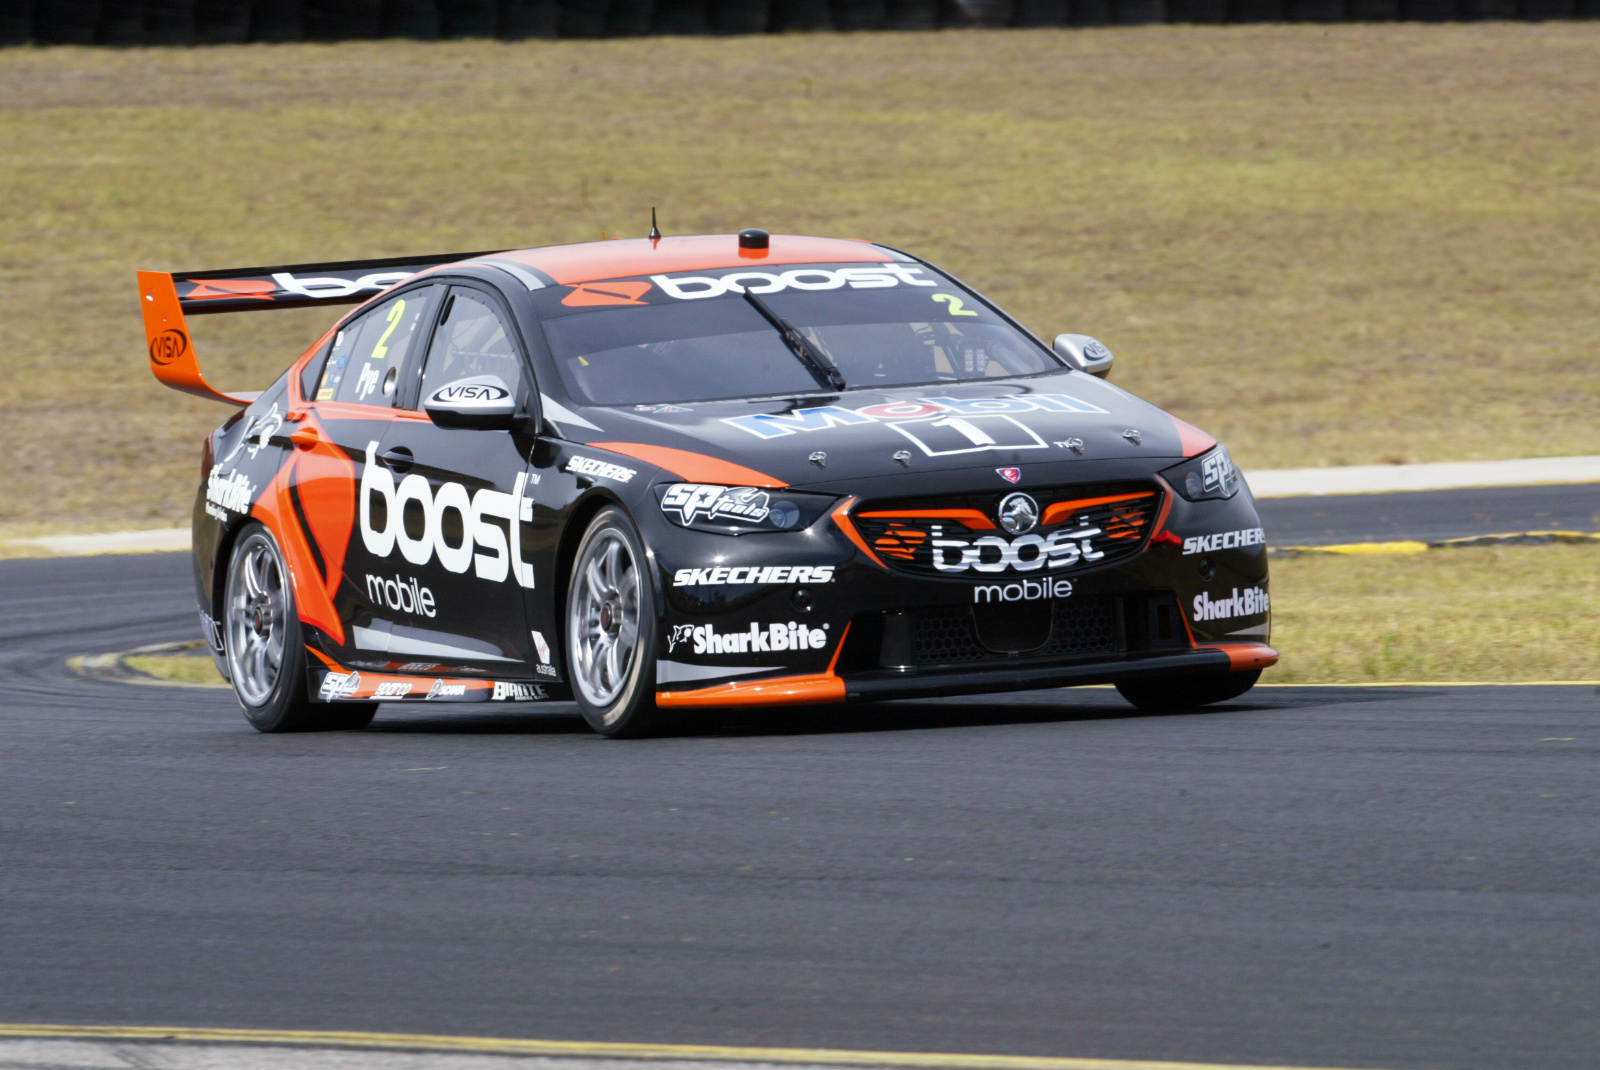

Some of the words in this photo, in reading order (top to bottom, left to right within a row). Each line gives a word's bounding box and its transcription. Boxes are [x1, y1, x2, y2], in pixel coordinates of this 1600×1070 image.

[650, 263, 938, 300] boost
[931, 293, 979, 316] 2
[371, 299, 406, 358] 2
[154, 336, 180, 358] VISA
[355, 362, 380, 400] Pye
[447, 386, 491, 400] VISA
[719, 394, 1110, 440] Mobil
[931, 417, 996, 446] 1
[565, 455, 637, 483] SKECHERS
[360, 440, 536, 589] boost
[663, 484, 725, 521] SP
[931, 515, 1105, 573] boost
[672, 565, 836, 587] SKECHERS
[974, 577, 1073, 603] mobile
[365, 573, 437, 618] mobile
[1193, 586, 1269, 622] SharkBite
[692, 621, 830, 655] SharkBite
